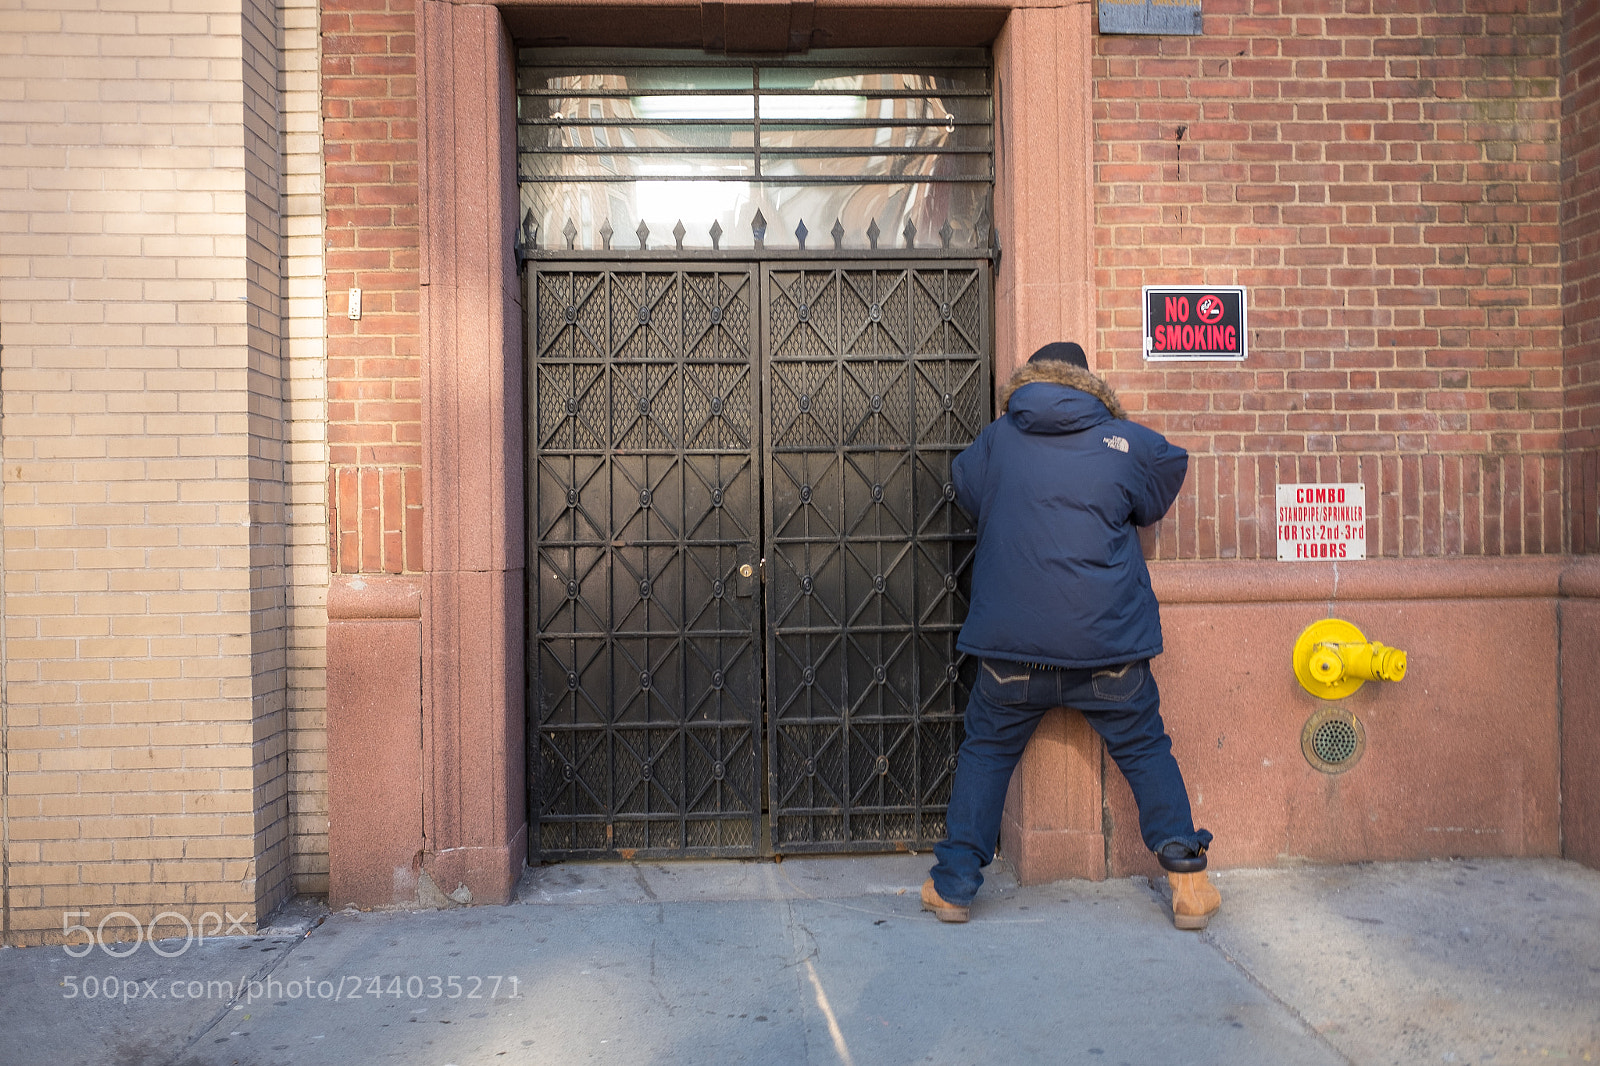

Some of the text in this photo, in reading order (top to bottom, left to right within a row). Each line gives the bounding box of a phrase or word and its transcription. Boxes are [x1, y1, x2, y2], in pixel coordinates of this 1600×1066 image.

[1165, 296, 1190, 323] NO
[1154, 324, 1237, 351] SMOKING
[1296, 488, 1345, 504] COMBO
[1278, 525, 1298, 541] FOR
[1296, 543, 1347, 558] FLOORS
